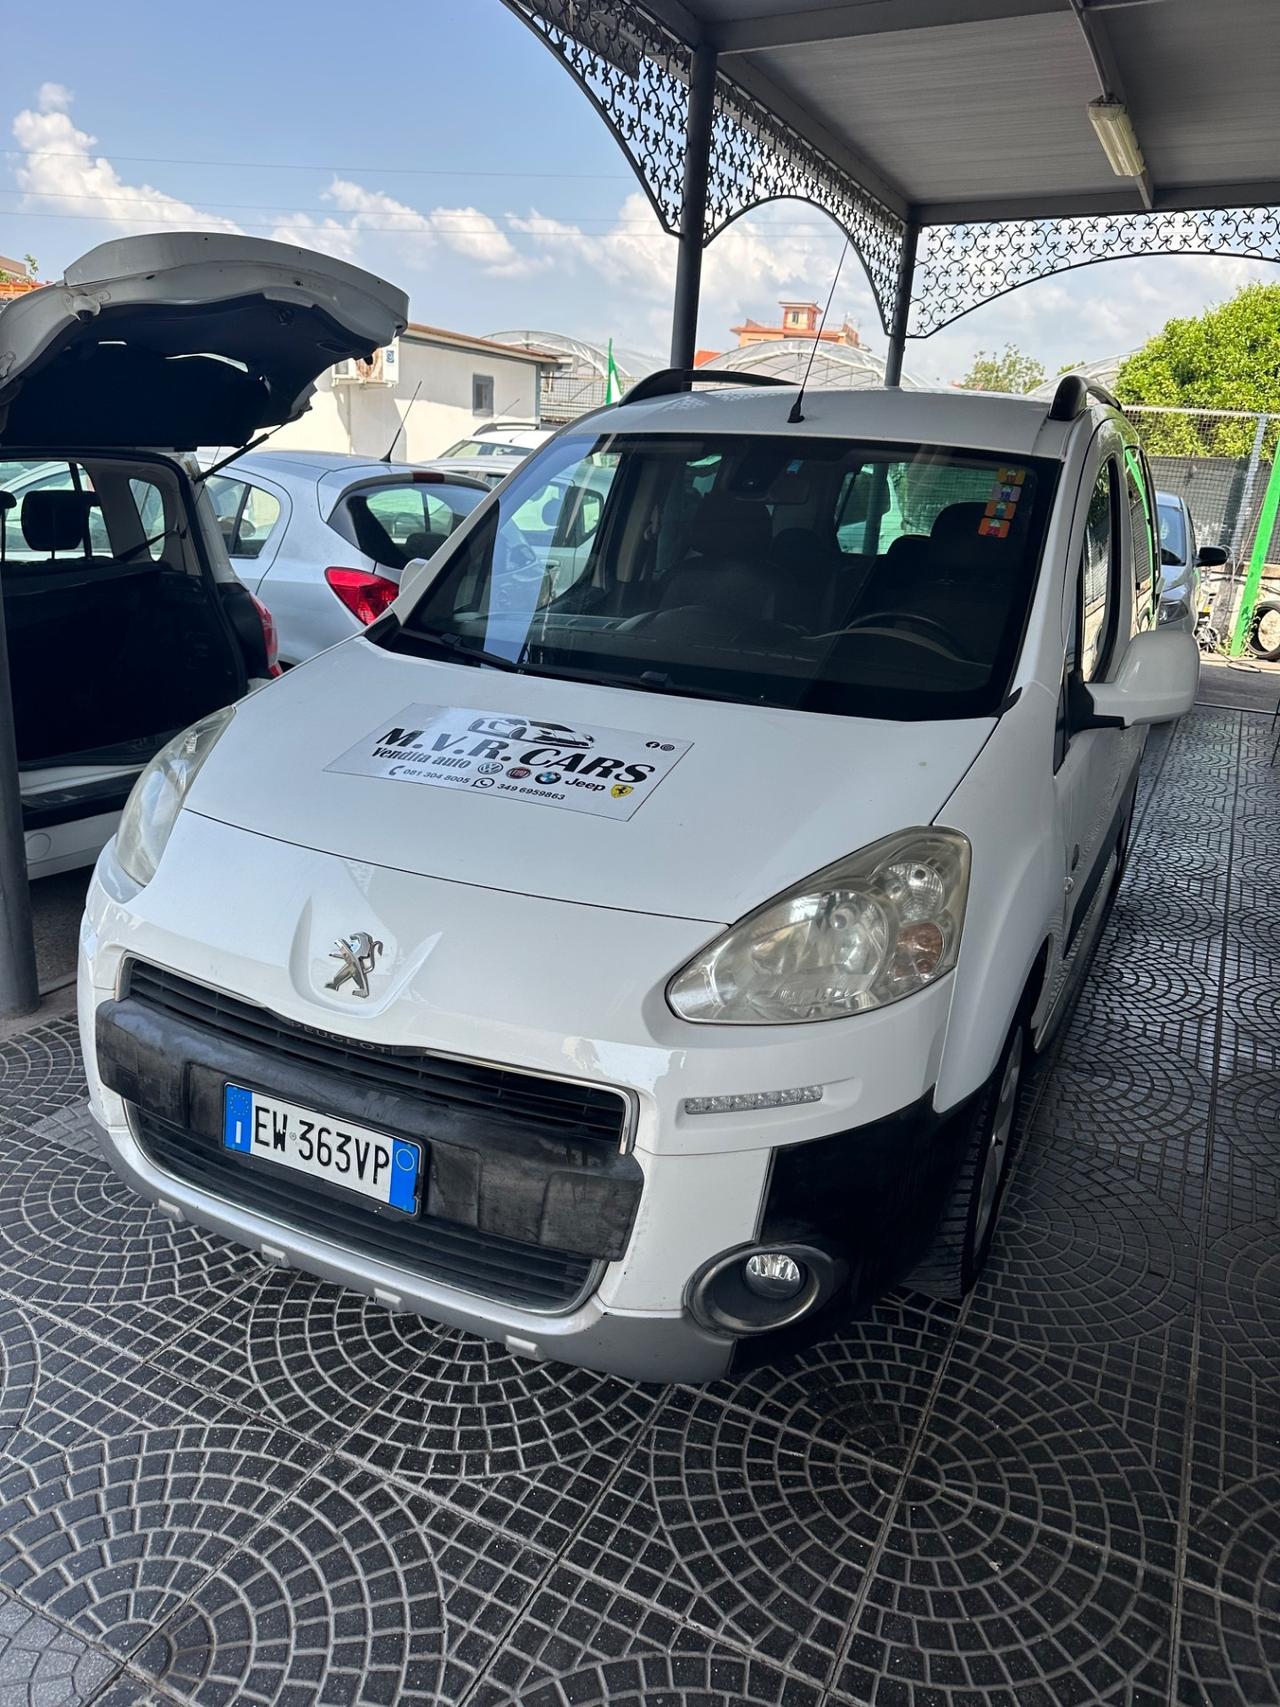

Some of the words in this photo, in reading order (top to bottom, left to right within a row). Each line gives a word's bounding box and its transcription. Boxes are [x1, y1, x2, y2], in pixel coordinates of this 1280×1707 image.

[372, 747, 431, 763] Vendita
[432, 756, 471, 768] auto
[497, 783, 517, 792] 349
[564, 778, 606, 792] Jeep
[289, 1020, 391, 1054] PEUGEOT
